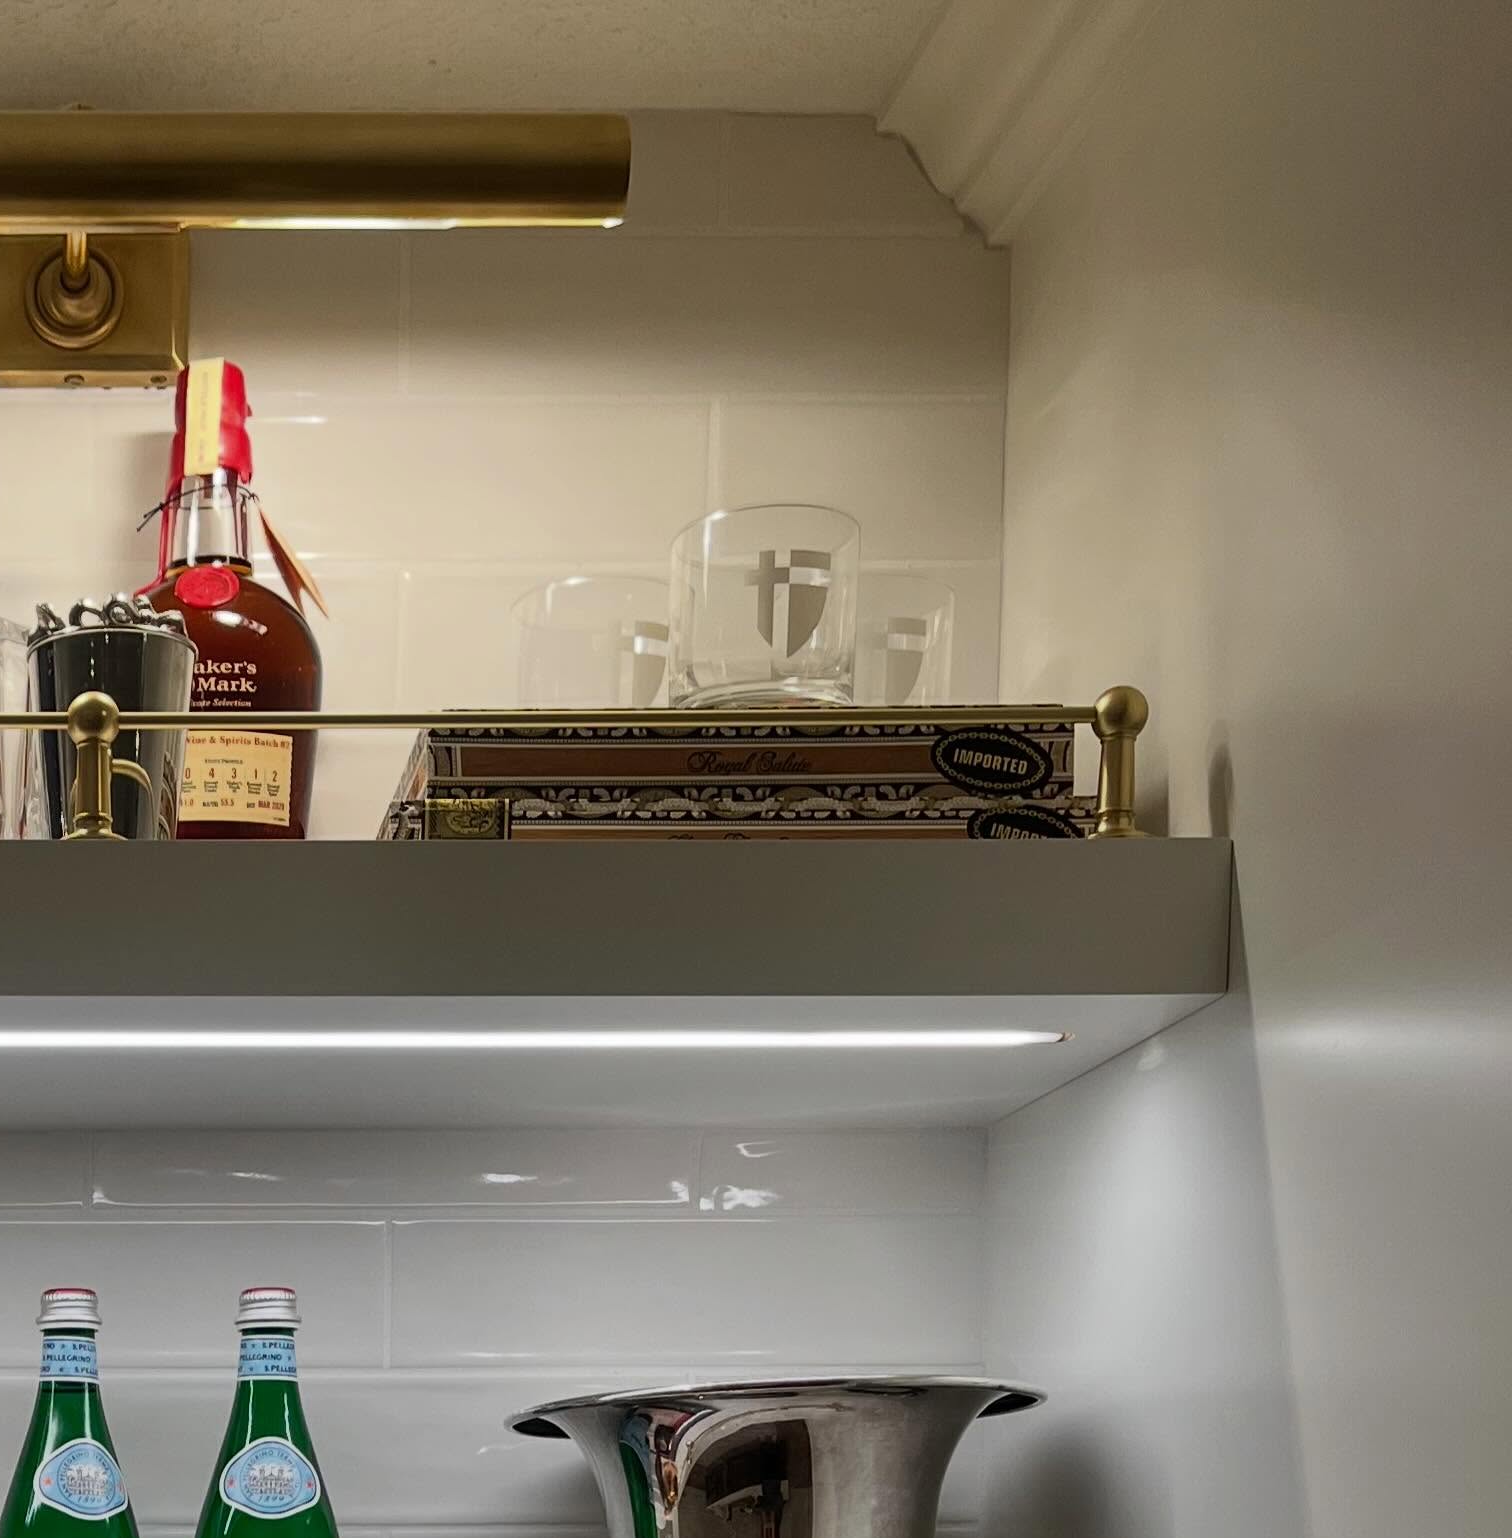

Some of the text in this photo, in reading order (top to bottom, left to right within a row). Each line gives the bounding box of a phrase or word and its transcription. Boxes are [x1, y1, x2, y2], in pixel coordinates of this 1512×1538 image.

[193, 660, 257, 675] aker's
[197, 677, 257, 693] Mark
[212, 698, 252, 707] Selection
[209, 736, 216, 744] &
[219, 736, 251, 746] Spirits
[254, 738, 278, 748] Batch
[953, 748, 1028, 775] IMPORTED
[209, 768, 215, 778] 4
[231, 768, 237, 779] 3
[253, 768, 258, 779] 1
[272, 770, 278, 782] 2
